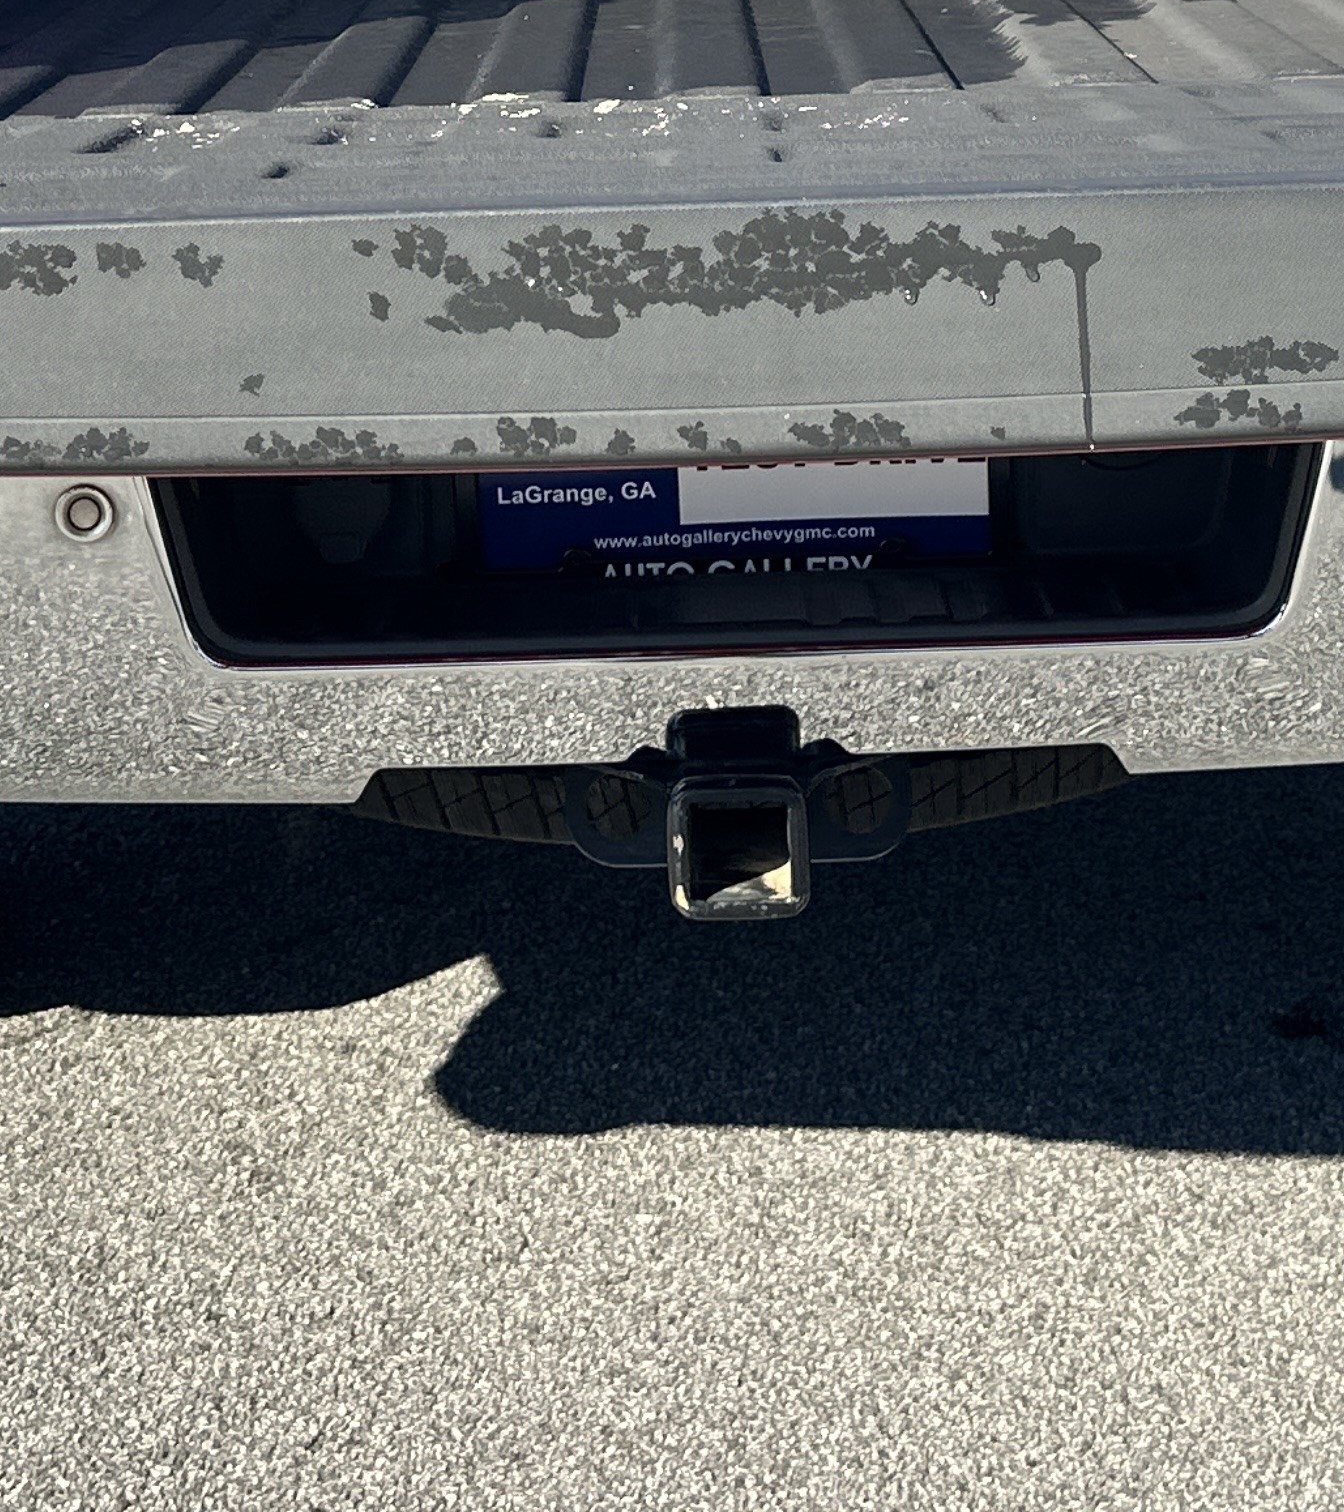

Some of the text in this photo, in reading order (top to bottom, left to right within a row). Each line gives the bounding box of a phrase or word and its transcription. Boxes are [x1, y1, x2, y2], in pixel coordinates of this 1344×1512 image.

[497, 481, 656, 506] LaGrange, GA
[594, 525, 875, 549] www.autogallerychevygmc.com
